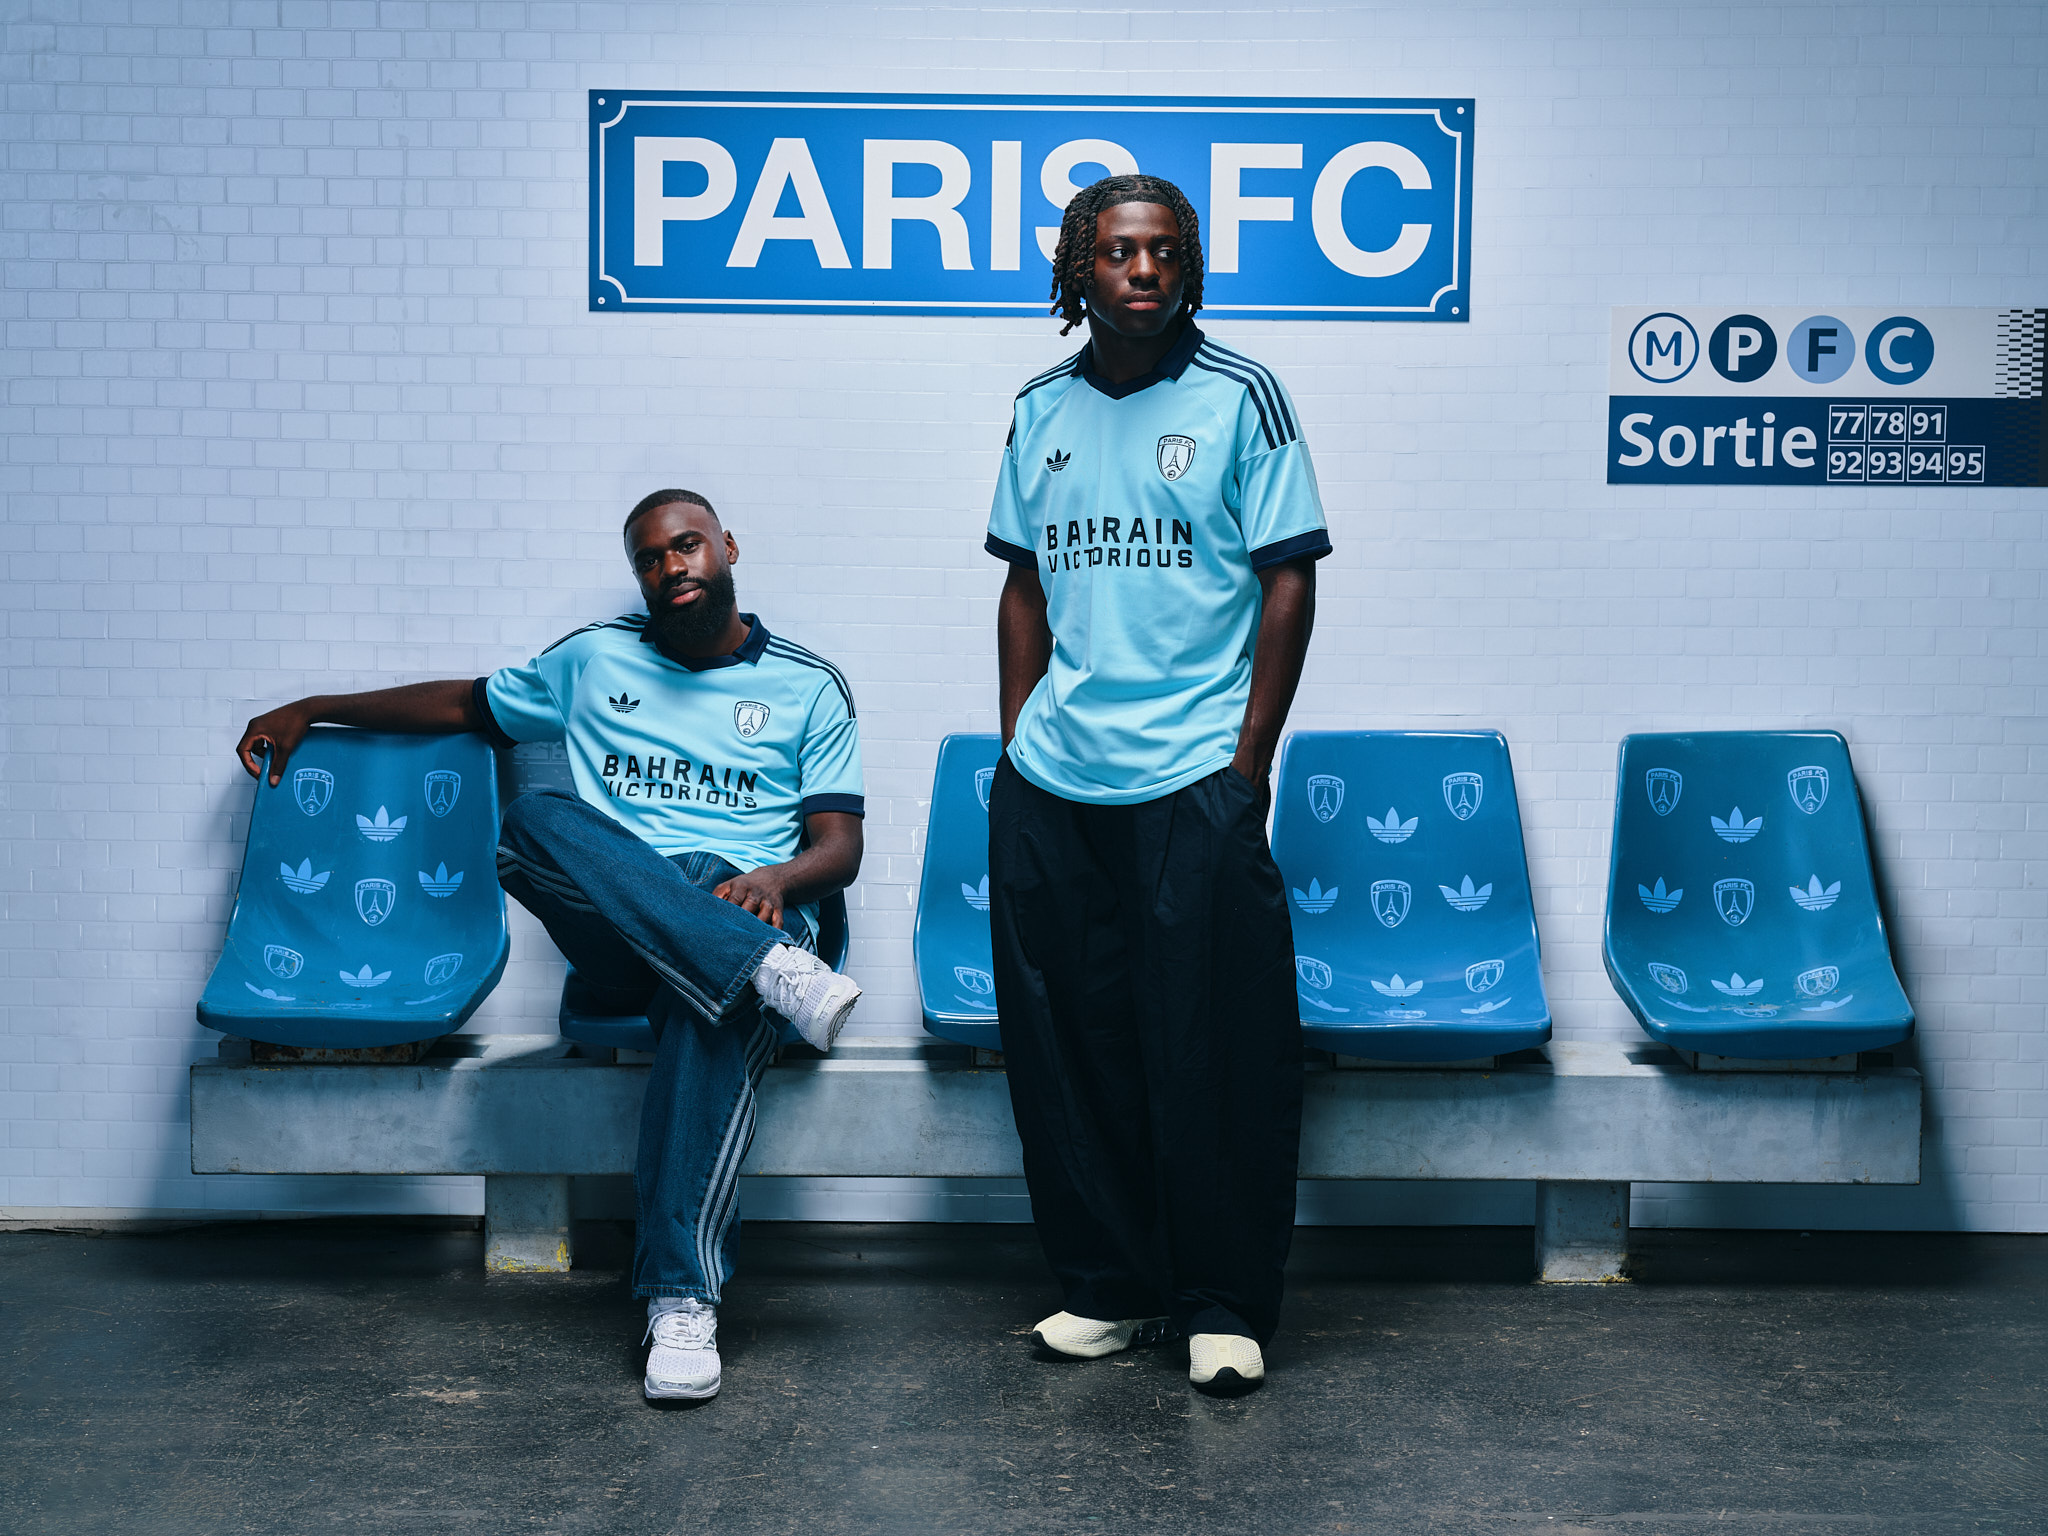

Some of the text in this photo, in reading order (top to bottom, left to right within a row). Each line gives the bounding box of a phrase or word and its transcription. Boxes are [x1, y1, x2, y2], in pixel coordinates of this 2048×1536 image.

[1208, 140, 1433, 278] FC
[1645, 326, 1915, 373] M P F C
[1831, 412, 1942, 435] 77 78 91
[1618, 412, 1817, 467] Sortie
[1830, 451, 1982, 475] 92 93 94 95
[1046, 516, 1193, 550] BAHRAIN
[1047, 547, 1193, 573] VICTORIOUS
[320, 774, 330, 782] FC
[602, 754, 758, 792] BAHRAIN
[1792, 770, 1813, 778] PARIS
[602, 780, 757, 808] VICTORIOUS
